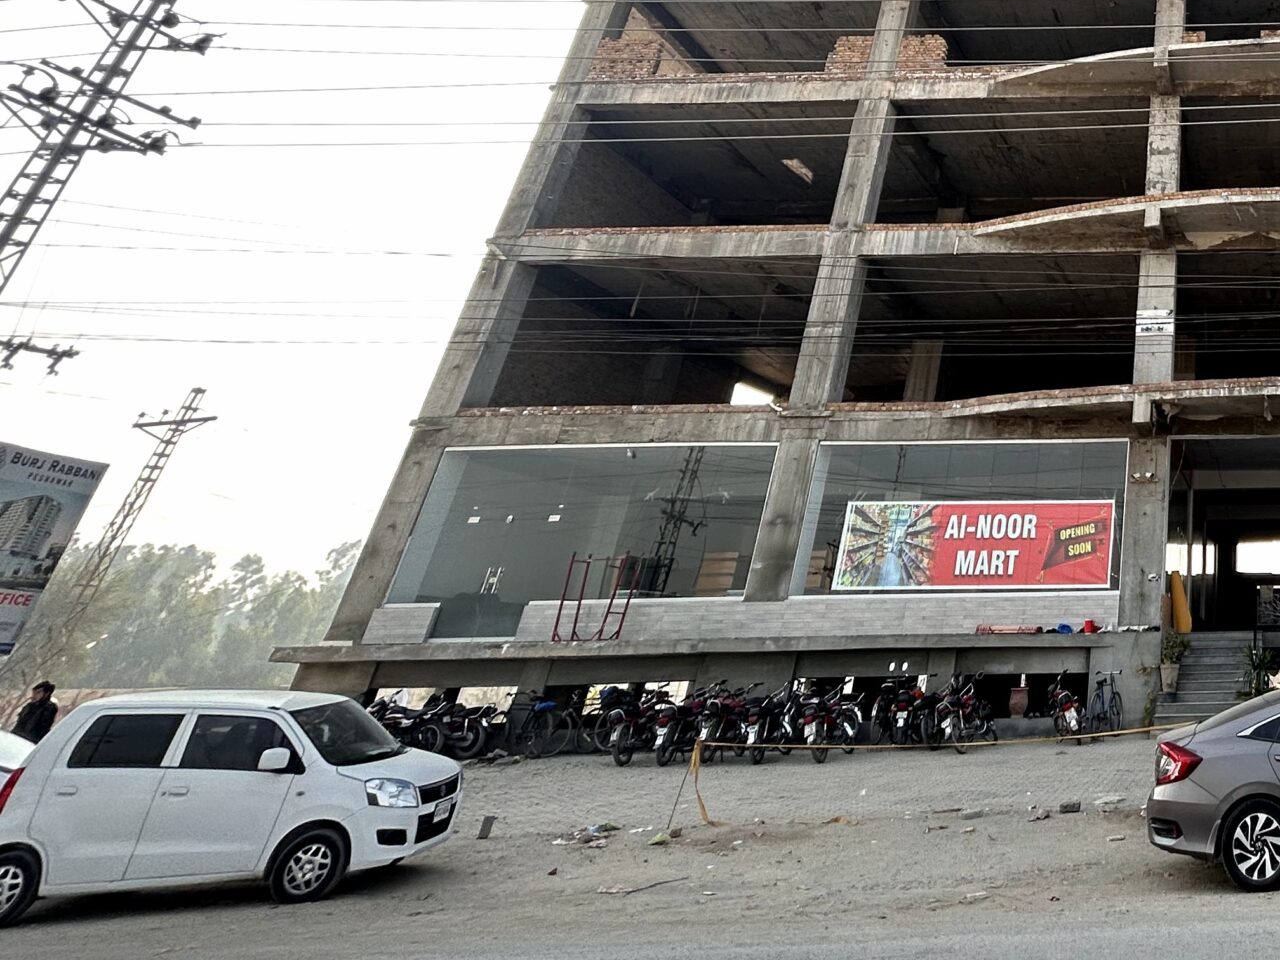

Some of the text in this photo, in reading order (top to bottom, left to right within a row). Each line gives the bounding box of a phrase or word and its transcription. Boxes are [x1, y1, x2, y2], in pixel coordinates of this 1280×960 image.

[11, 451, 46, 470] BURJ
[1059, 523, 1096, 540] OPENING
[1067, 541, 1092, 556] SOON
[954, 550, 1020, 575] MART
[0, 591, 33, 607] FICE
